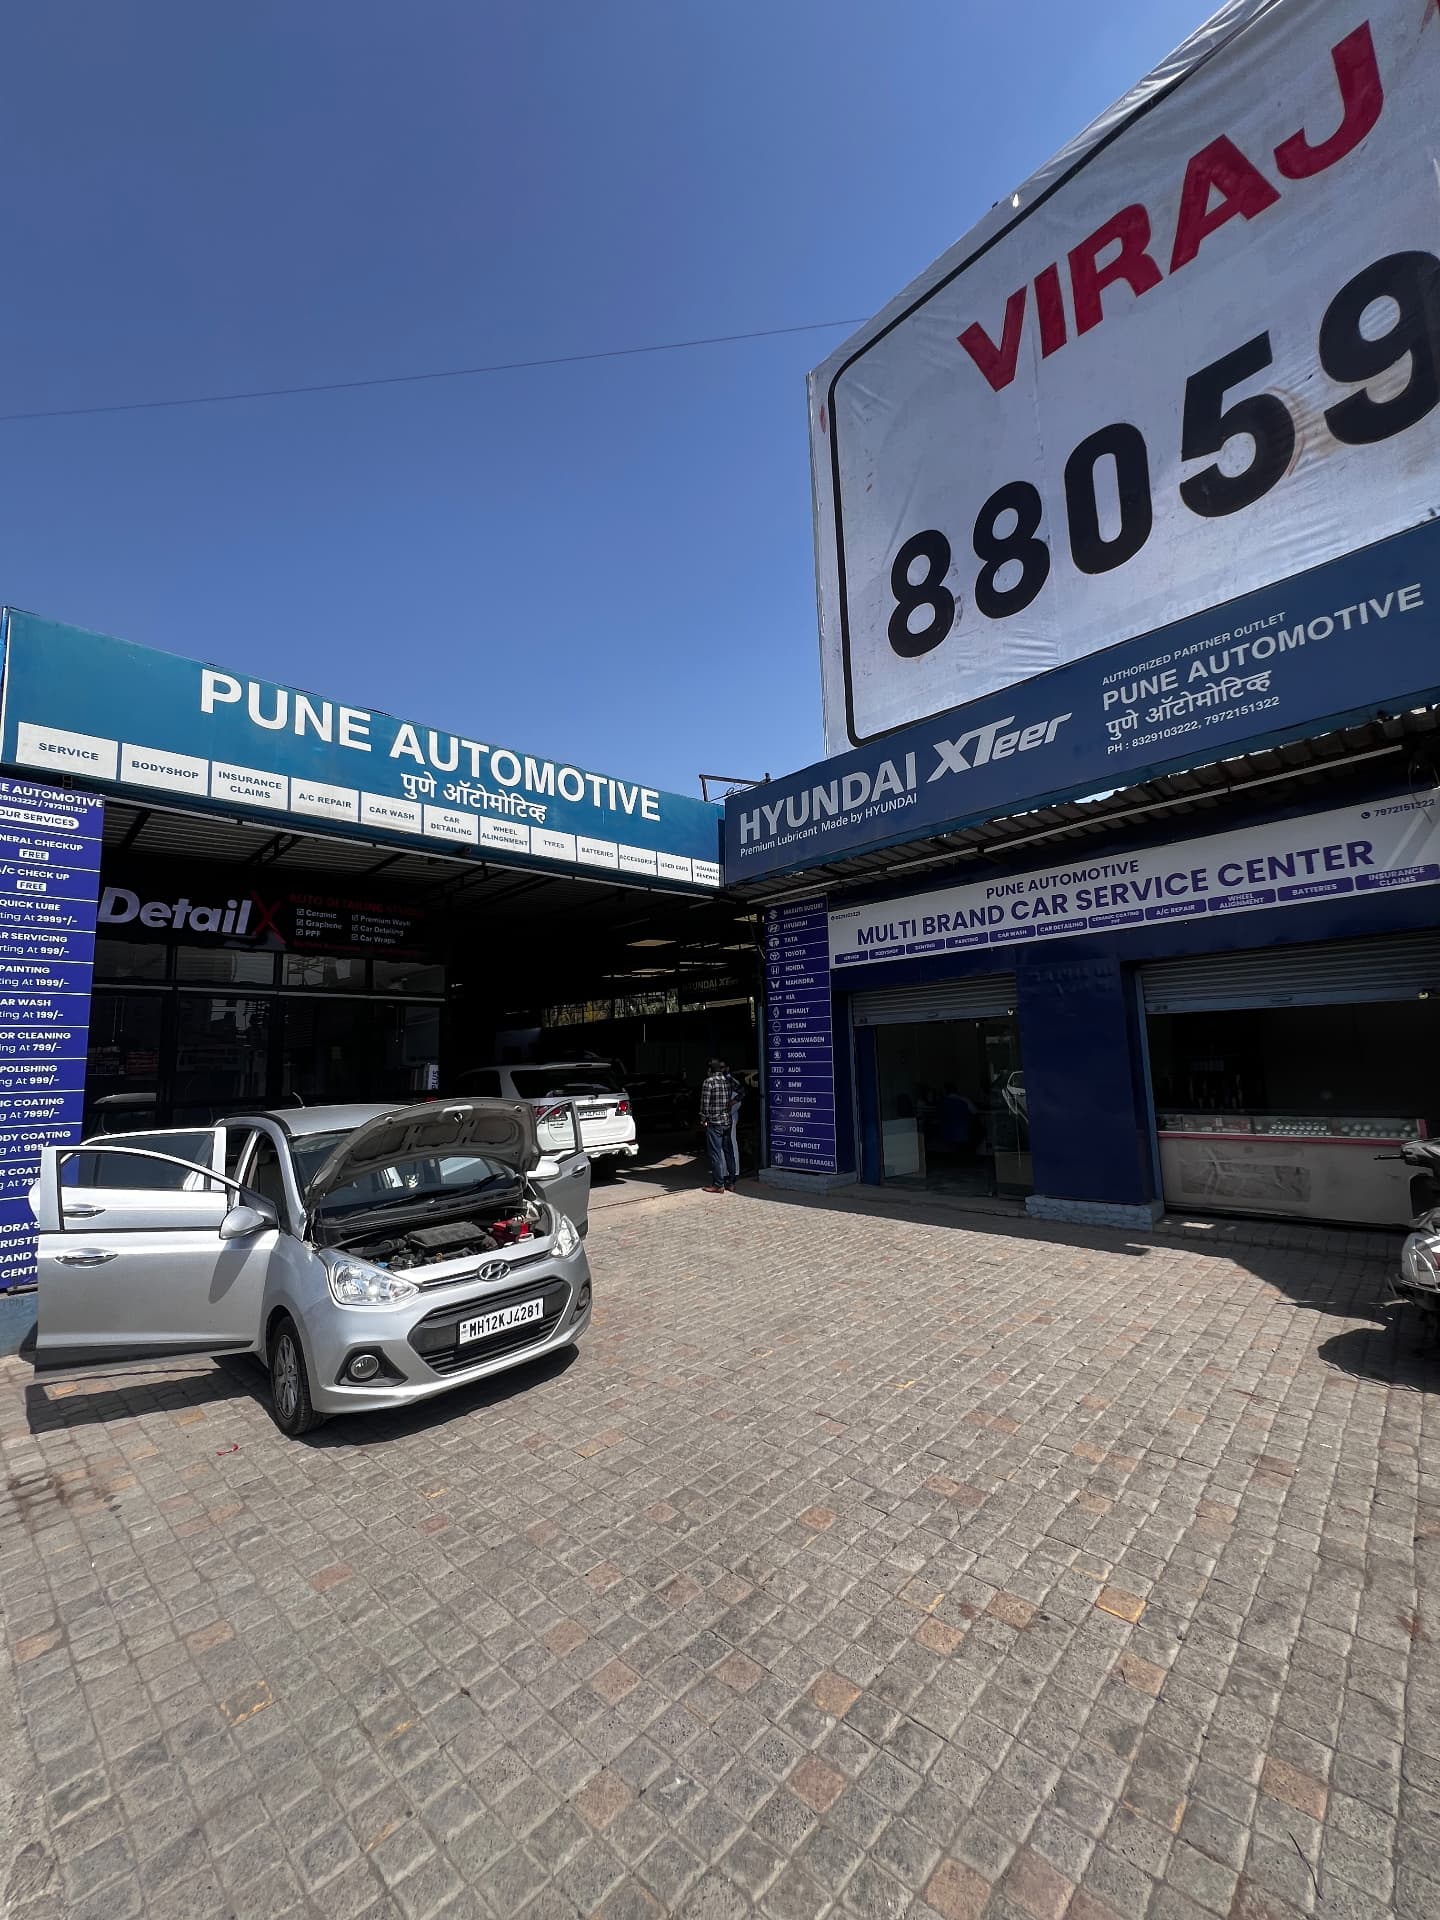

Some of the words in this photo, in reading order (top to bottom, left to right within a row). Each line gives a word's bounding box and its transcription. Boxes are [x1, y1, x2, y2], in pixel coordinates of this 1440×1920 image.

[957, 19, 1384, 392] VIRAJ
[1102, 655, 1171, 685] AUTHORIZED
[1174, 634, 1231, 661] PARTNER
[1234, 612, 1286, 639] OUTLET
[1103, 669, 1179, 711] PUNE
[1187, 583, 1424, 683] AUTOMOTIVE
[1106, 711, 1139, 740] पुणे
[1145, 671, 1272, 724] ऑटोमोटिव्ह
[1107, 744, 1123, 755] PH
[1204, 696, 1280, 725] 7972151322
[200, 669, 372, 752] PUNE
[390, 724, 661, 822] AUTOMOTIVE
[39, 742, 99, 761] SERVICE
[131, 760, 199, 779] BODYSHOP
[218, 771, 282, 789] INSURANCE
[740, 752, 917, 845] HYUNDAI
[926, 712, 1073, 783] XTeer
[12, 785, 103, 808] AUTOMOTIVE
[230, 785, 271, 799] CLAIMS
[401, 771, 437, 800] पुणे
[443, 780, 548, 823] ऑटोमोटिव्ह
[299, 792, 315, 802] A/C
[317, 796, 352, 808] REPAIR
[369, 806, 387, 815] CAR
[390, 809, 415, 820] WASH
[23, 812, 75, 827] SERVICES
[443, 815, 460, 823] CAR
[431, 823, 472, 836] DETAILING
[493, 825, 518, 835] WHEEL
[740, 841, 775, 857] Premium
[777, 825, 818, 846] Lubricant
[821, 816, 848, 832] Made
[850, 809, 863, 824] by
[865, 793, 917, 818] HYUNDAI
[34, 839, 83, 851] CHECKUP
[544, 839, 565, 849] TYRES
[22, 850, 46, 859] FREE
[581, 847, 614, 858] BATTERIES
[17, 869, 53, 879] CHECK
[56, 873, 70, 881] UP
[1368, 866, 1425, 881] INSURANCE
[986, 882, 1024, 900] PUNE
[1028, 860, 1139, 892] AUTOMOTIVE
[1379, 876, 1417, 887] CLAIMS
[20, 881, 44, 890] FREE
[1292, 883, 1338, 896] BATTERIES
[857, 919, 917, 945] MULTI
[922, 904, 1004, 935] BRAND
[1010, 894, 1068, 921] CAR
[1075, 868, 1209, 911] SERVICE
[1217, 840, 1375, 887] CENTER
[1228, 893, 1254, 902] WHEEL
[0, 899, 33, 909] QUICK
[36, 902, 61, 911] LUBE
[1219, 897, 1265, 909] ALIGNMENT
[306, 910, 336, 919] Ceramic
[1156, 907, 1169, 916] A/C
[1170, 905, 1195, 914] REPAIR
[306, 920, 342, 930] Graphene
[360, 925, 373, 933] Car
[1040, 924, 1052, 932] CAR
[1053, 921, 1084, 931] DETAILING
[11, 933, 68, 943] SERVICING
[360, 935, 373, 943] Car
[784, 936, 798, 944] TATA
[26, 946, 38, 954] At
[785, 949, 806, 958] TOYOTA
[785, 964, 805, 972] HONDA
[786, 1007, 809, 1015] RENAULT
[786, 1022, 807, 1030] NISSAN
[17, 1032, 71, 1040] CLEANING
[787, 1036, 825, 1044] VOLKSWAGEN
[0, 1065, 57, 1073] POLISHING
[15, 1077, 27, 1085] At
[14, 1098, 65, 1106] COATING
[788, 1096, 817, 1104] MERCEDES
[9, 1111, 21, 1119] At
[789, 1111, 811, 1119] JAGUAR
[21, 1130, 71, 1140] COATING
[789, 1126, 804, 1134] FORD
[9, 1144, 21, 1152] At
[789, 1141, 821, 1150] CHEVROLET
[809, 1159, 834, 1167] GARAGES
[7, 1179, 19, 1187] At
[470, 1302, 540, 1337] MH12KJ4281
